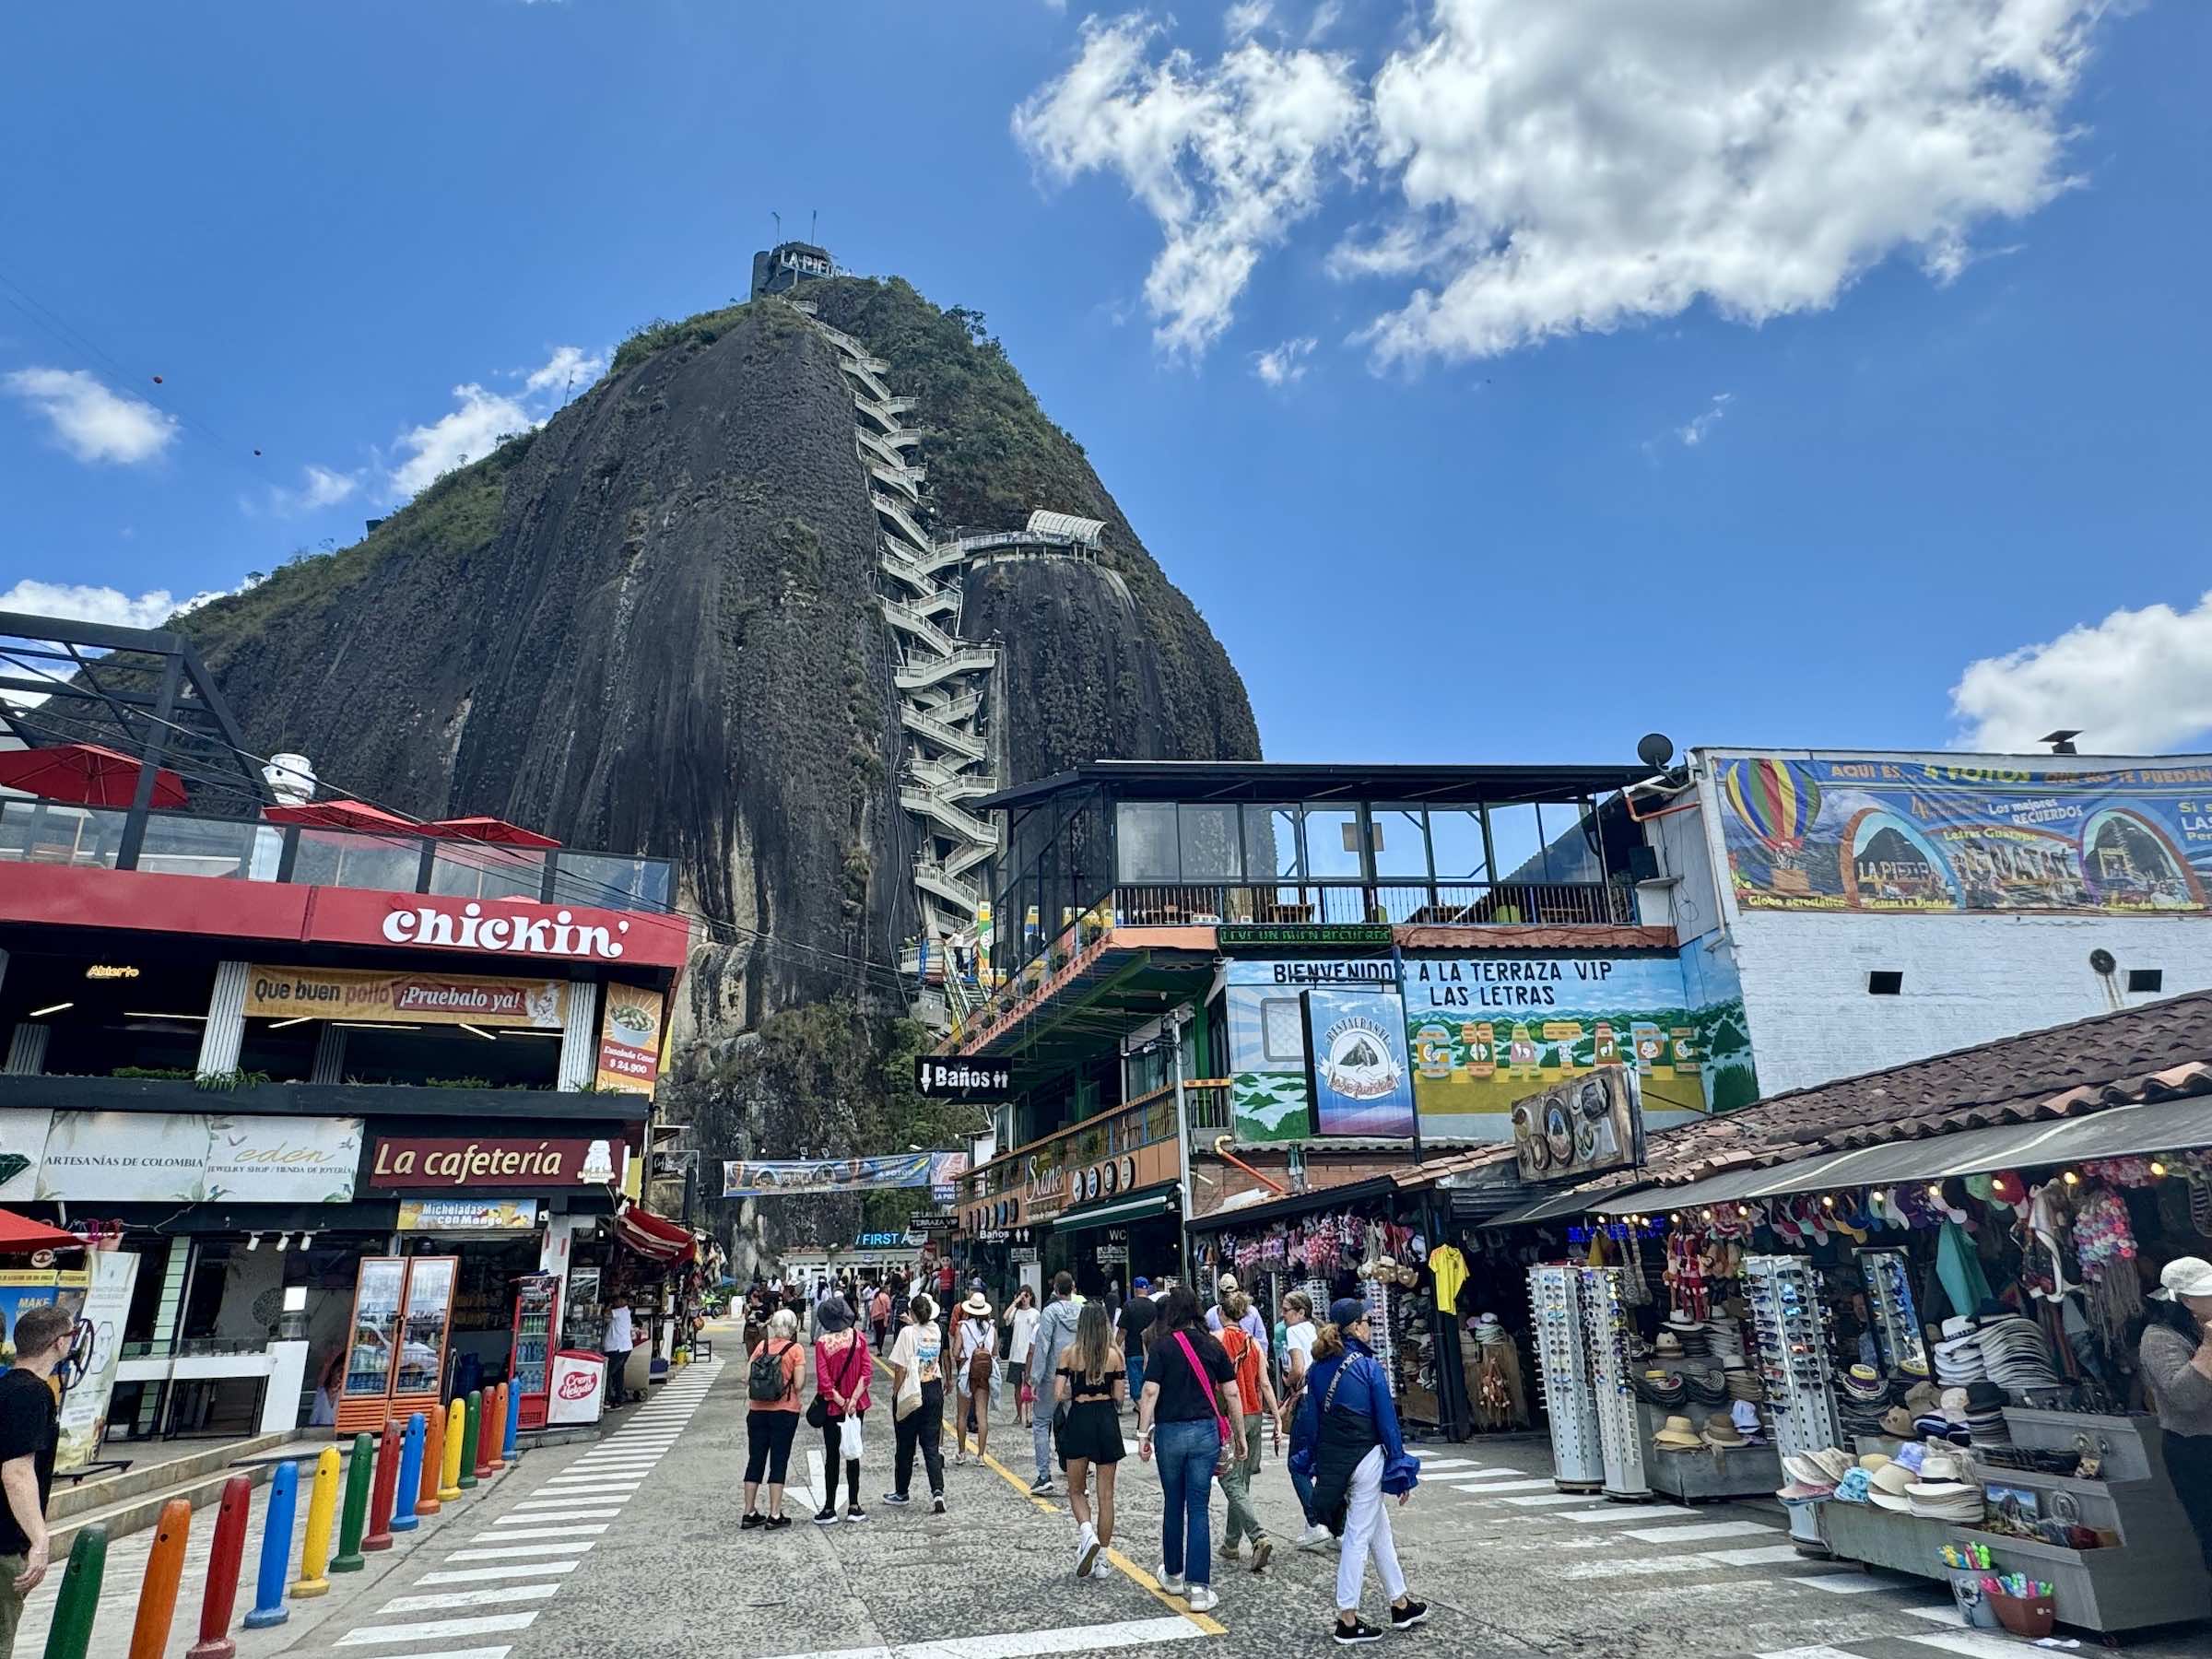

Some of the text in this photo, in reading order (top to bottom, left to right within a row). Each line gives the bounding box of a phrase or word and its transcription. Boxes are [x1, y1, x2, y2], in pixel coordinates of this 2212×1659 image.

[1831, 765, 1876, 778] AQUI
[2140, 768, 2212, 783] PUEDEN
[1988, 804, 2009, 816] Los
[2011, 805, 2083, 826] RECUERDOS
[382, 902, 629, 959] chickin'
[1419, 962, 1430, 982] A
[1439, 962, 1462, 982] LA
[1472, 961, 1562, 982] TERRAZA
[1574, 961, 1612, 981] VIP
[254, 979, 290, 1003] Que
[294, 980, 341, 1002] buen
[399, 986, 488, 1008] ¡Pruebalo
[491, 993, 521, 1012] ya!
[1430, 985, 1556, 1006] LAS LETRAS
[935, 1065, 991, 1088] Baños
[44, 1154, 204, 1168] ARTESANÍAS DE COLOMBIA
[374, 1142, 562, 1184] La cafetería
[207, 1165, 245, 1173] JEWELRY
[246, 1165, 269, 1173] SHOP
[276, 1165, 305, 1173] TIENDA
[307, 1165, 318, 1173] DE
[422, 1203, 483, 1216] Micheladas
[437, 1216, 503, 1227] con Mango
[912, 1218, 945, 1227] TERRAZA
[863, 1233, 899, 1245] FIRST
[980, 1229, 1010, 1241] Baños
[1109, 1229, 1127, 1241] WC
[18, 1297, 50, 1309] MAKE
